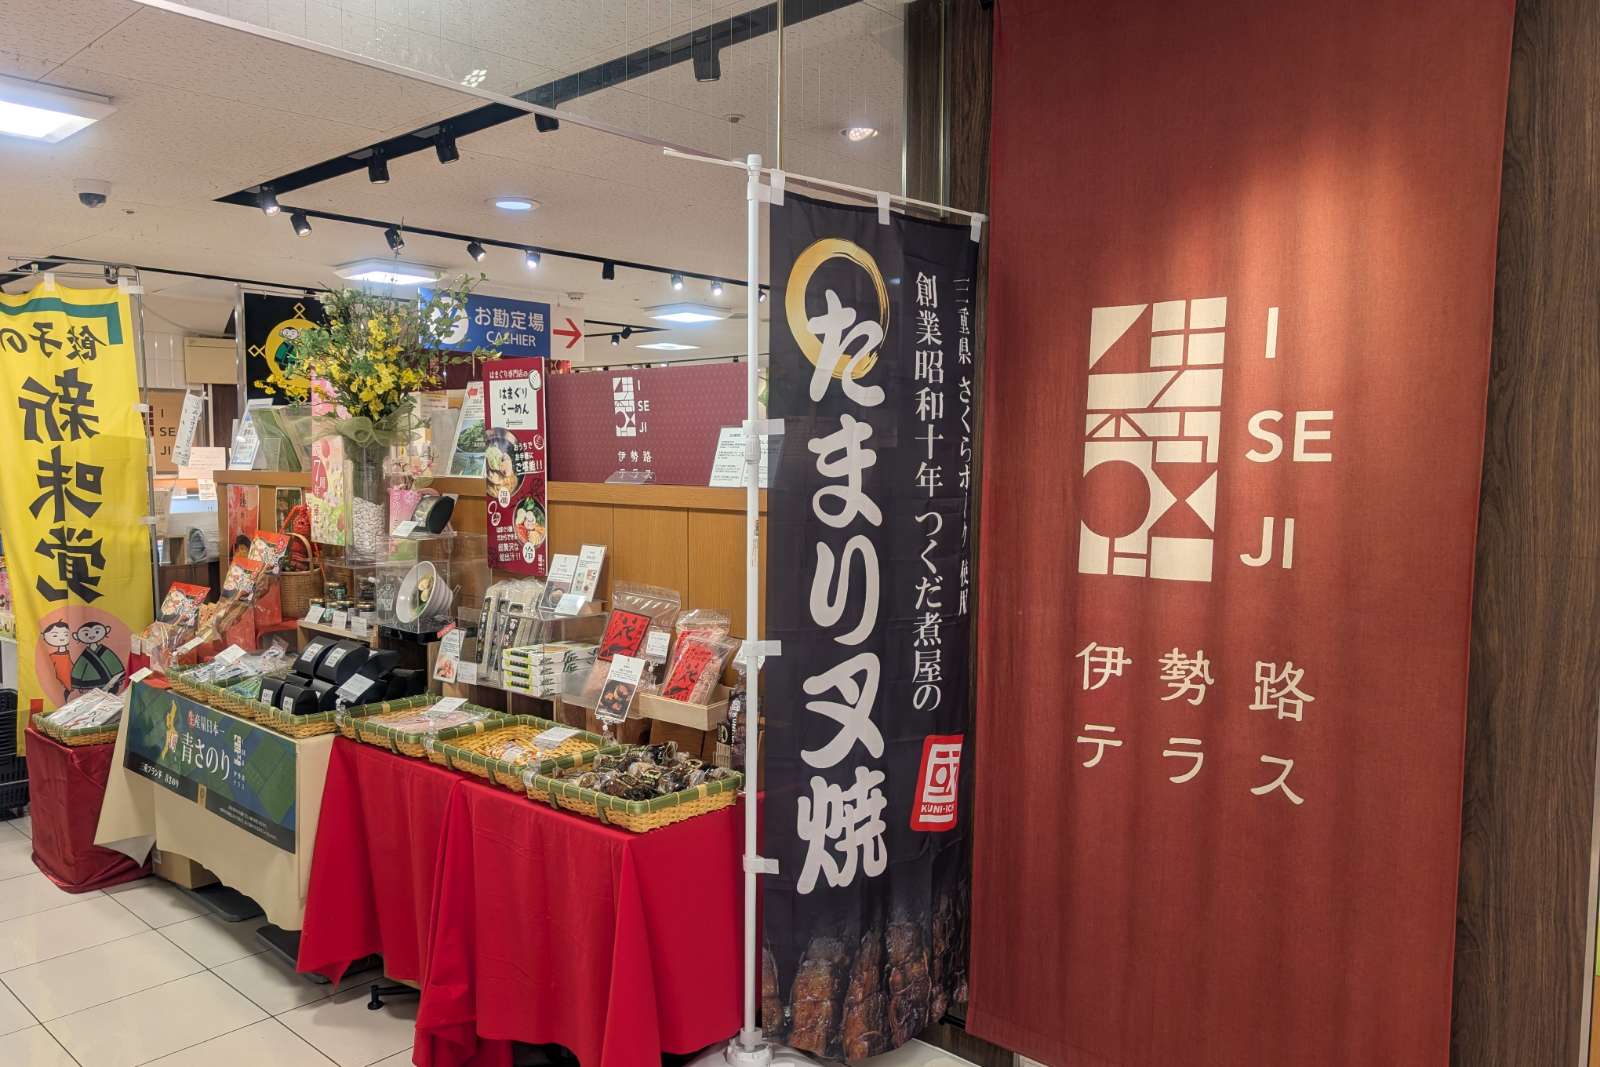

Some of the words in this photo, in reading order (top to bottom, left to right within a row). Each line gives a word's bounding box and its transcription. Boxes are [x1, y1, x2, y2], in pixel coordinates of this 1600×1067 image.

[475, 306, 545, 333] お勘定場
[1265, 306, 1279, 359] I
[499, 386, 528, 400] はまぐり
[501, 402, 530, 416] らーめん
[637, 400, 650, 412] SE
[914, 271, 945, 498] 創業昭和十年
[159, 426, 176, 437] SE
[160, 445, 171, 456] JI
[639, 421, 647, 433] JI
[1245, 409, 1334, 463] SE
[1240, 516, 1295, 569] JI
[912, 511, 944, 712] つくだ煮屋の
[1076, 641, 1315, 722] 伊勢路
[180, 731, 230, 781] 青さのり
[1076, 723, 1305, 806] テラス
